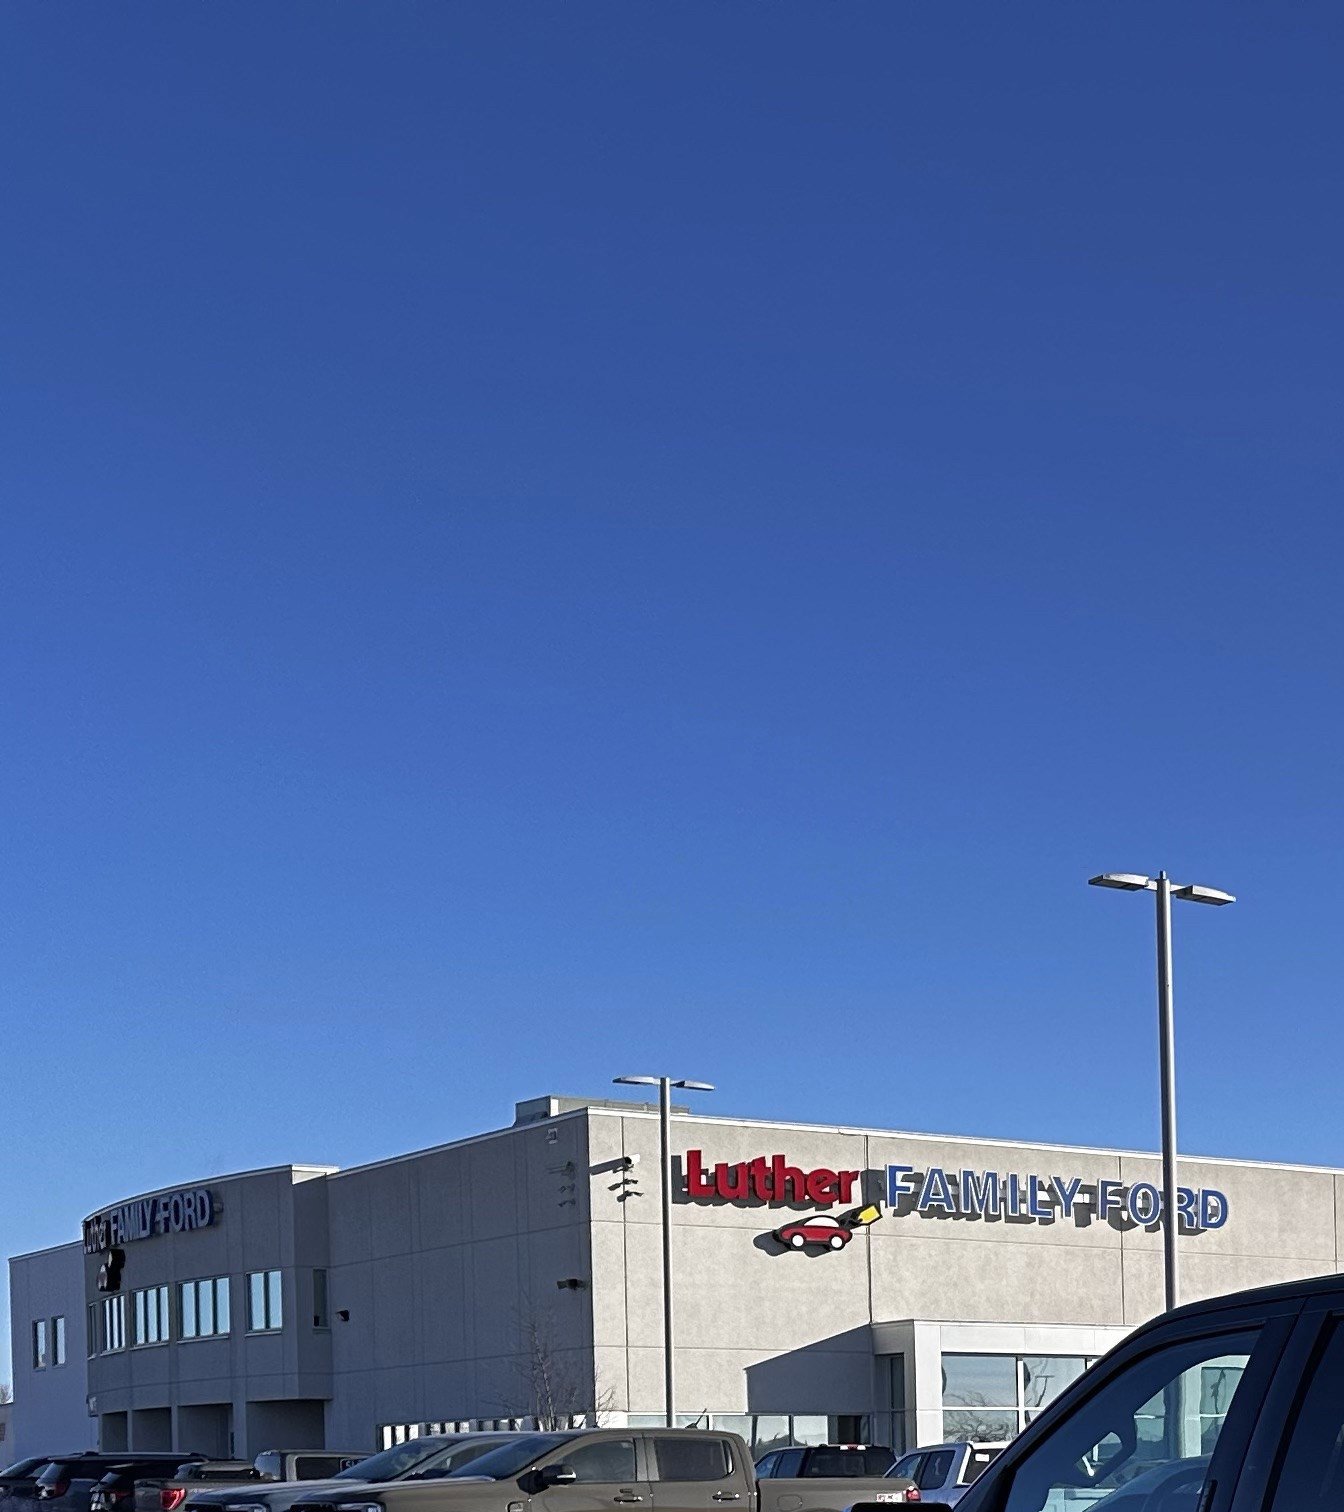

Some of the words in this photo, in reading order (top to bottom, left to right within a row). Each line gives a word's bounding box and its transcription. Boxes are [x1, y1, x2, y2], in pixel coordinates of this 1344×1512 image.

[110, 1199, 153, 1246] FAMILY
[159, 1189, 212, 1233] FORD
[687, 1150, 860, 1204] Luther
[885, 1163, 1082, 1219] FAMILY
[1097, 1177, 1229, 1230] FORD
